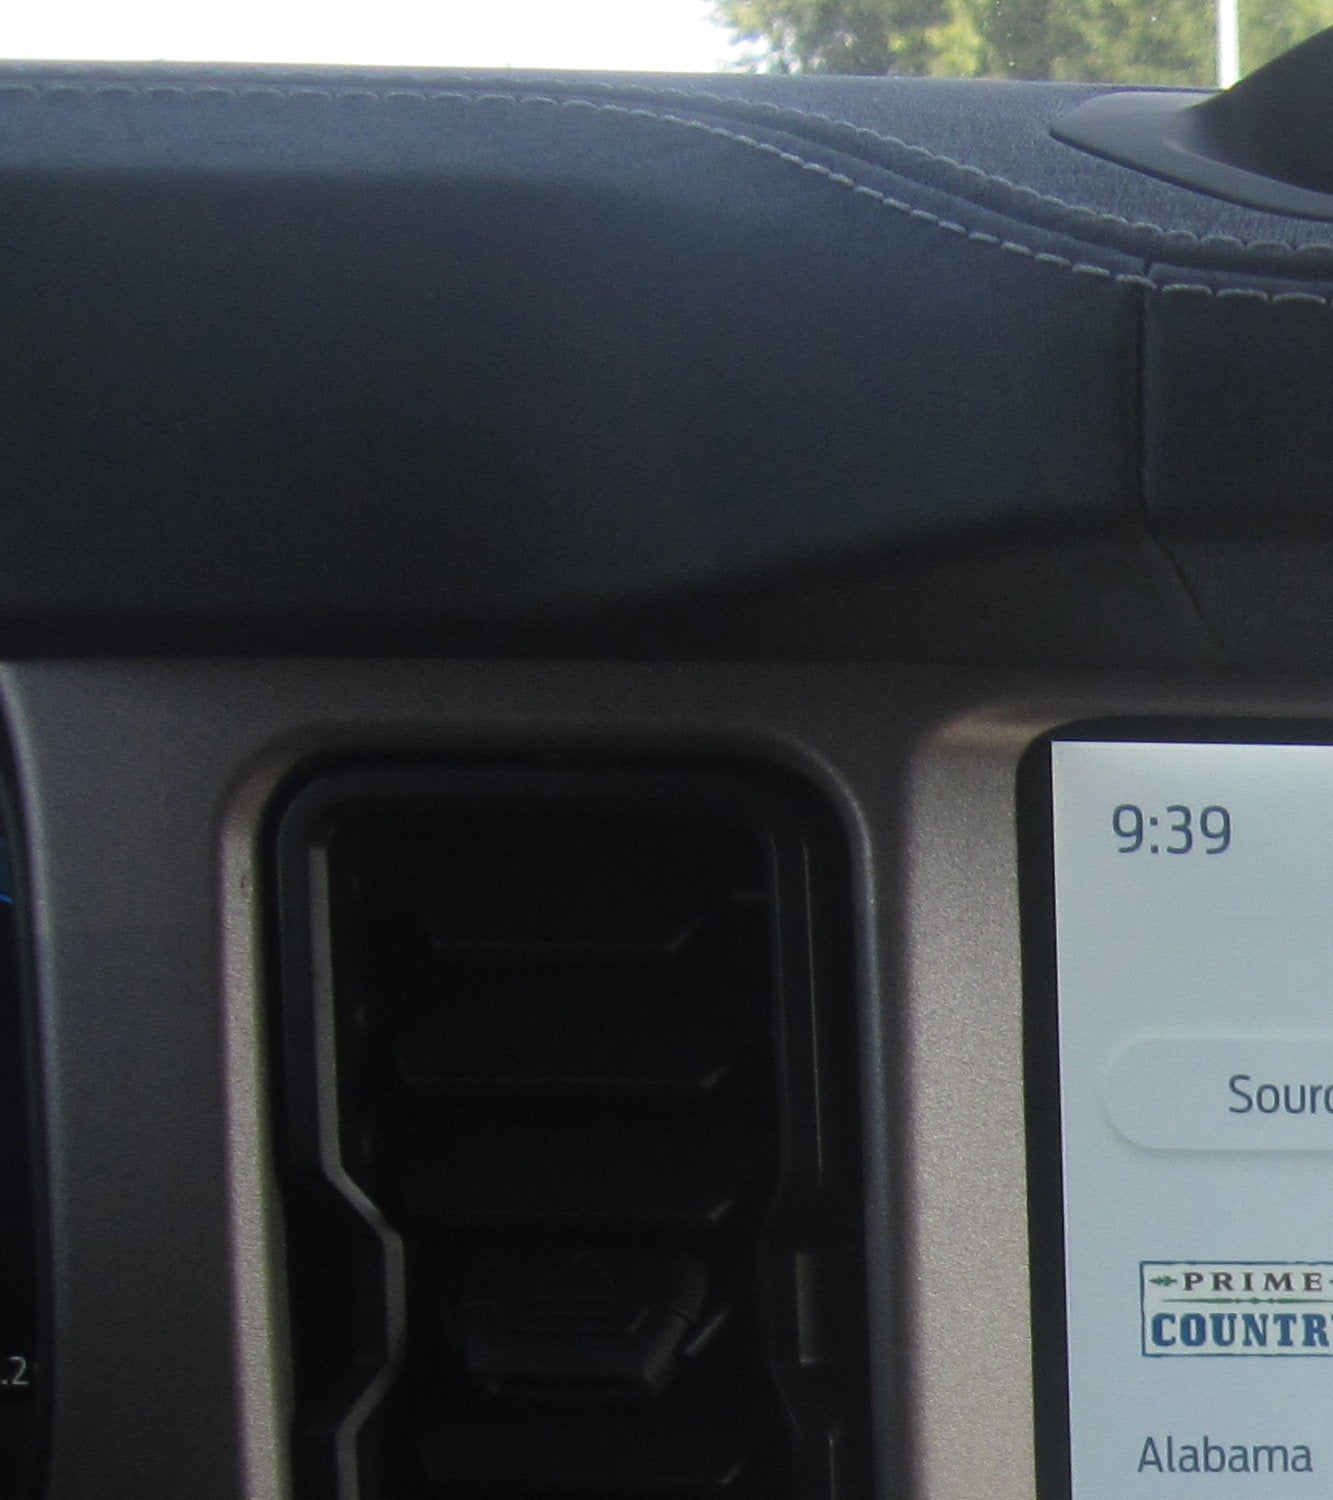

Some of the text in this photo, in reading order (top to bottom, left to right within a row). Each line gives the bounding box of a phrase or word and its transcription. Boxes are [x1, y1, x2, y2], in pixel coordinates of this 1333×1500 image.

[1111, 803, 1233, 856] 9:39
[1181, 1270, 1324, 1292] PRIME
[1136, 1435, 1314, 1474] Alabama
